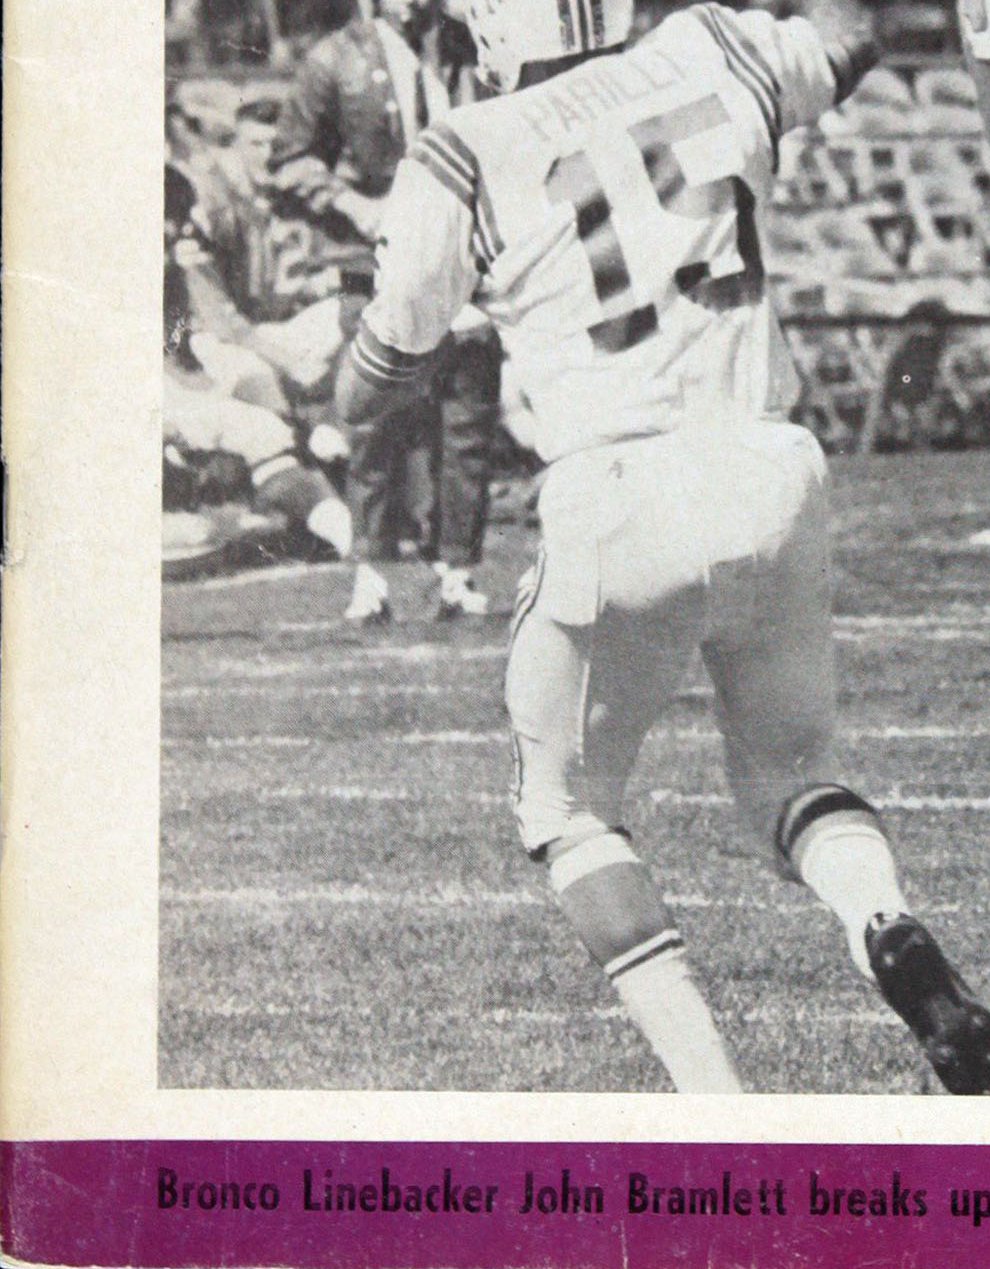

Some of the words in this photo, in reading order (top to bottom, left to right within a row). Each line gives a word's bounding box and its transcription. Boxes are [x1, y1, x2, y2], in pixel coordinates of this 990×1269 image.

[544, 93, 765, 353] 15
[158, 1167, 279, 1210] Bronco
[304, 1168, 497, 1213] Linebacker
[520, 1169, 603, 1213] John
[629, 1172, 786, 1215] Bramlett
[810, 1171, 927, 1216] breaks
